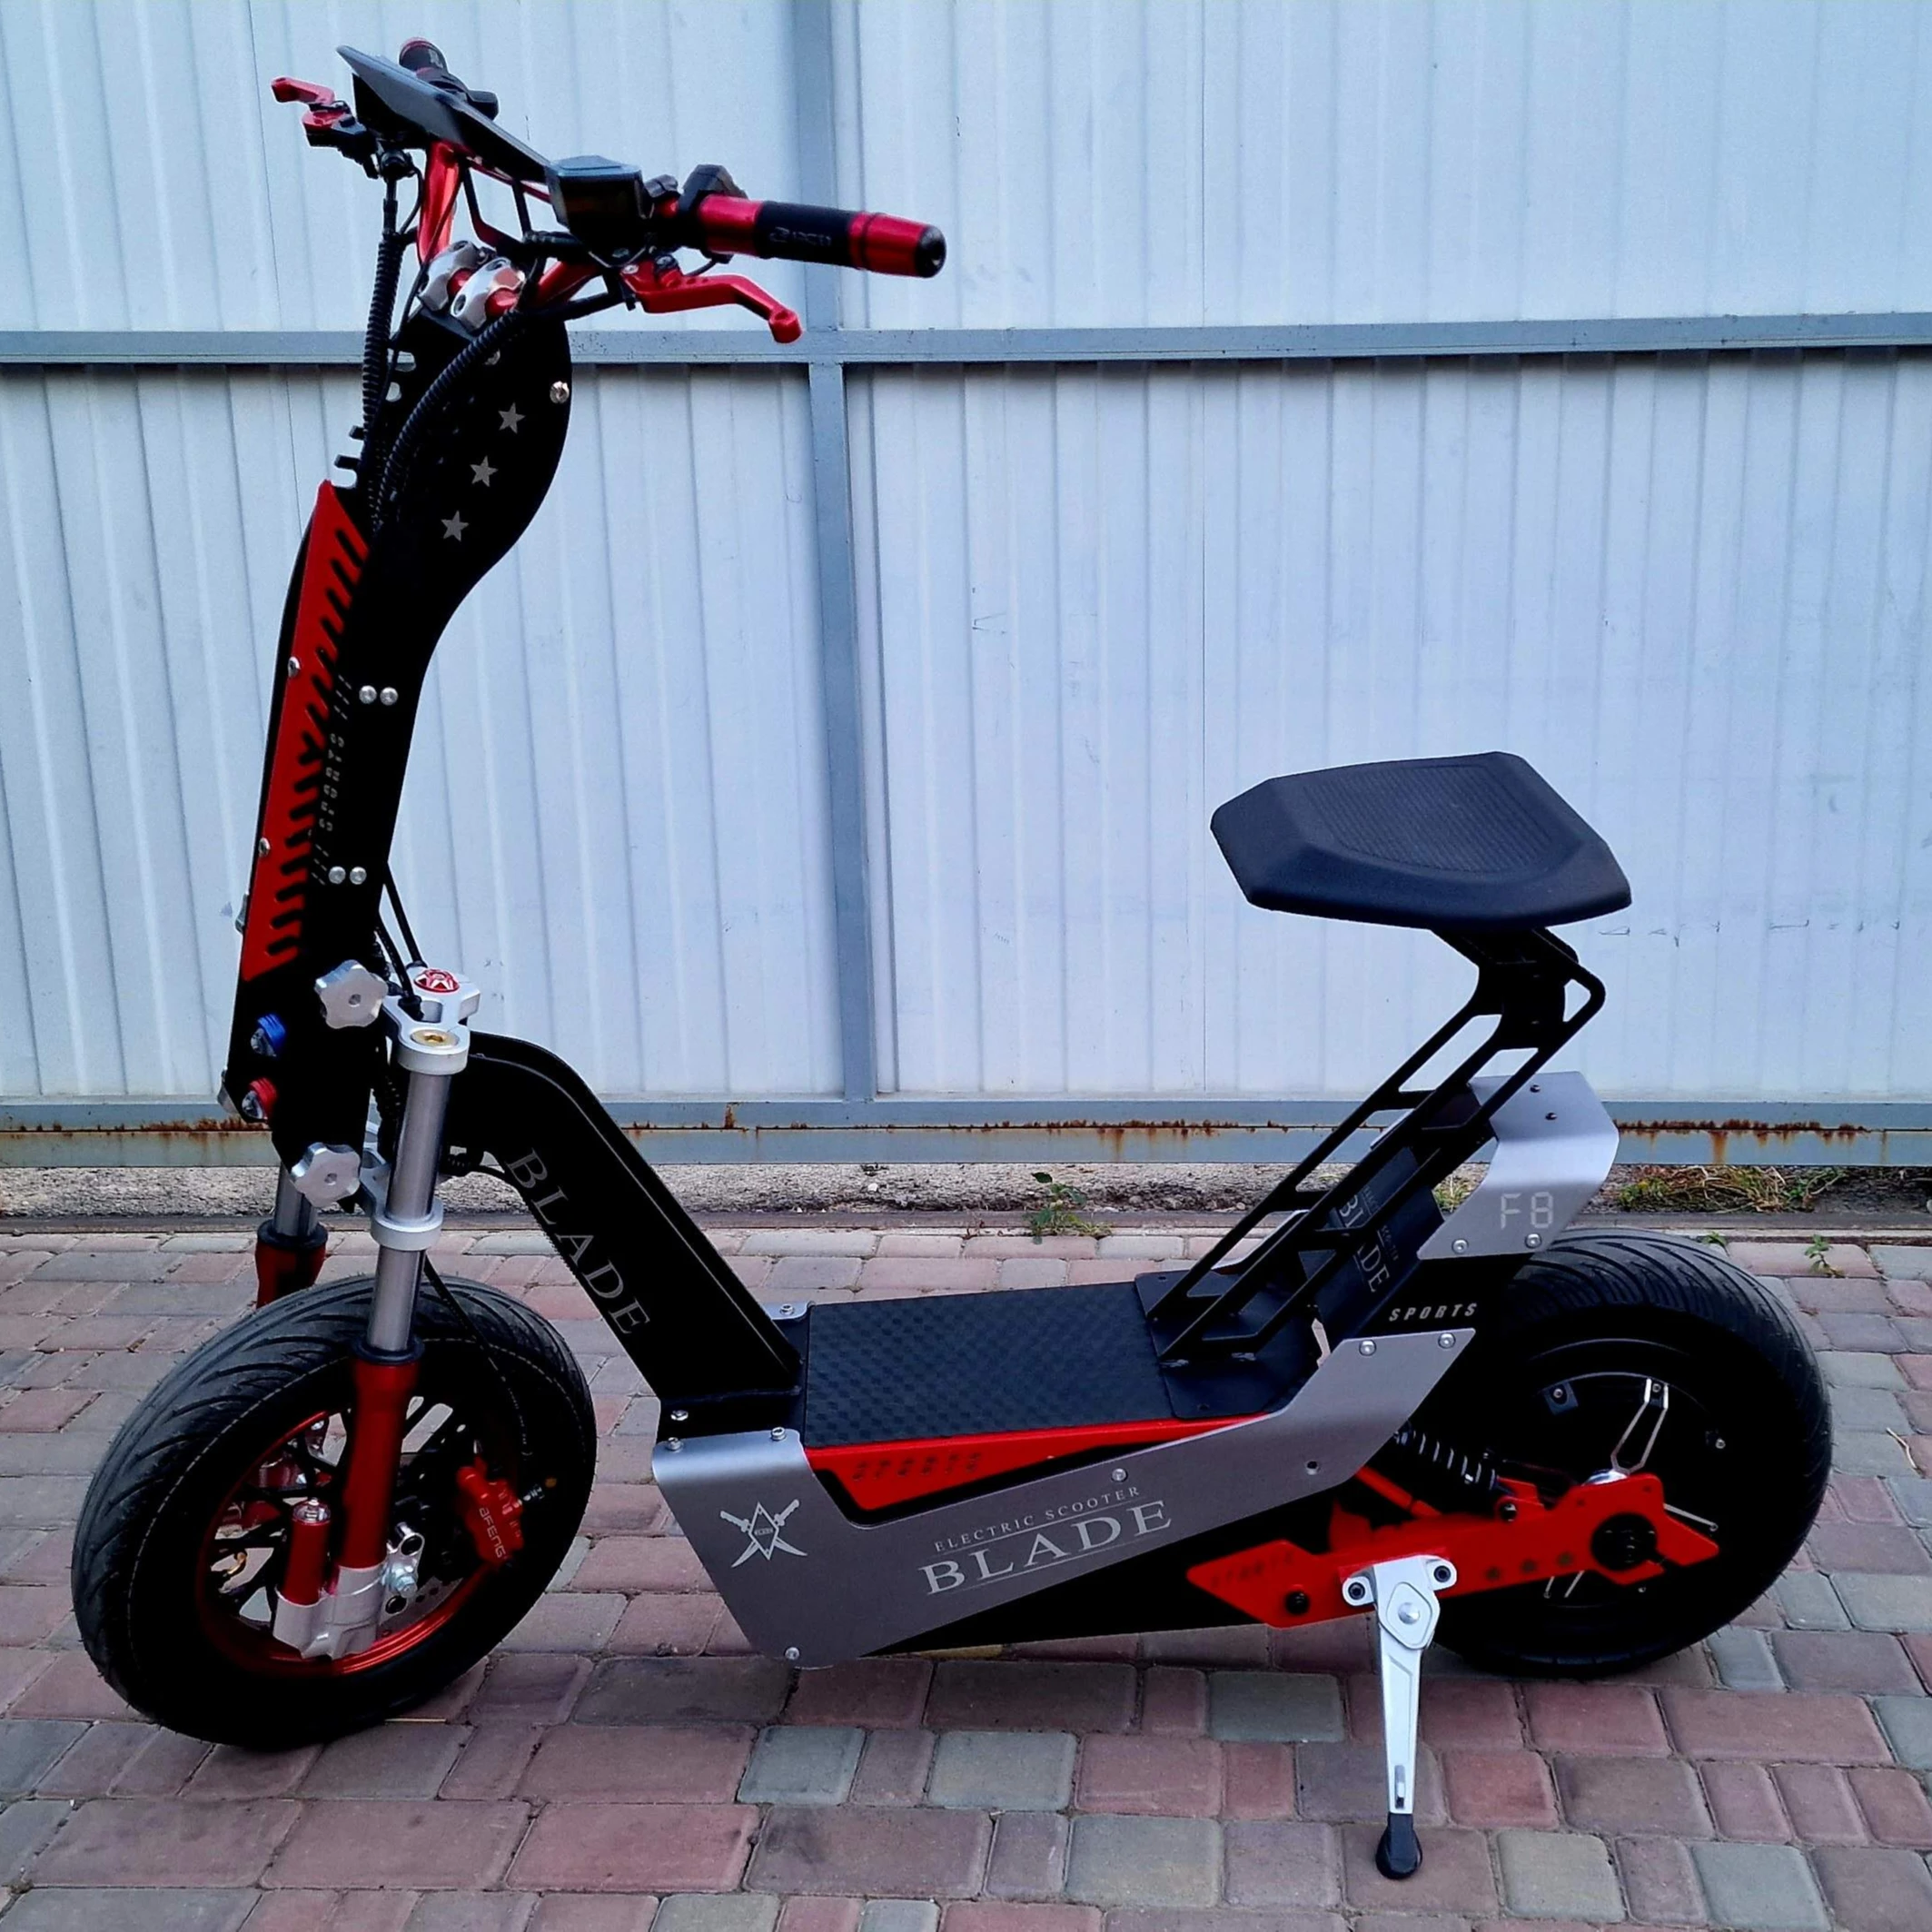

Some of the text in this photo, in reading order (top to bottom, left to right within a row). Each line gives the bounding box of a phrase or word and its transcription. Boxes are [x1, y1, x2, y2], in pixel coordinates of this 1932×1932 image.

[505, 1147, 650, 1334] BLADE
[1501, 1191, 1554, 1230] F8
[1389, 1303, 1478, 1322] SPORTS
[918, 1500, 1172, 1595] BLADE
[935, 1486, 1139, 1552] ELECTRIC SCOOTER
